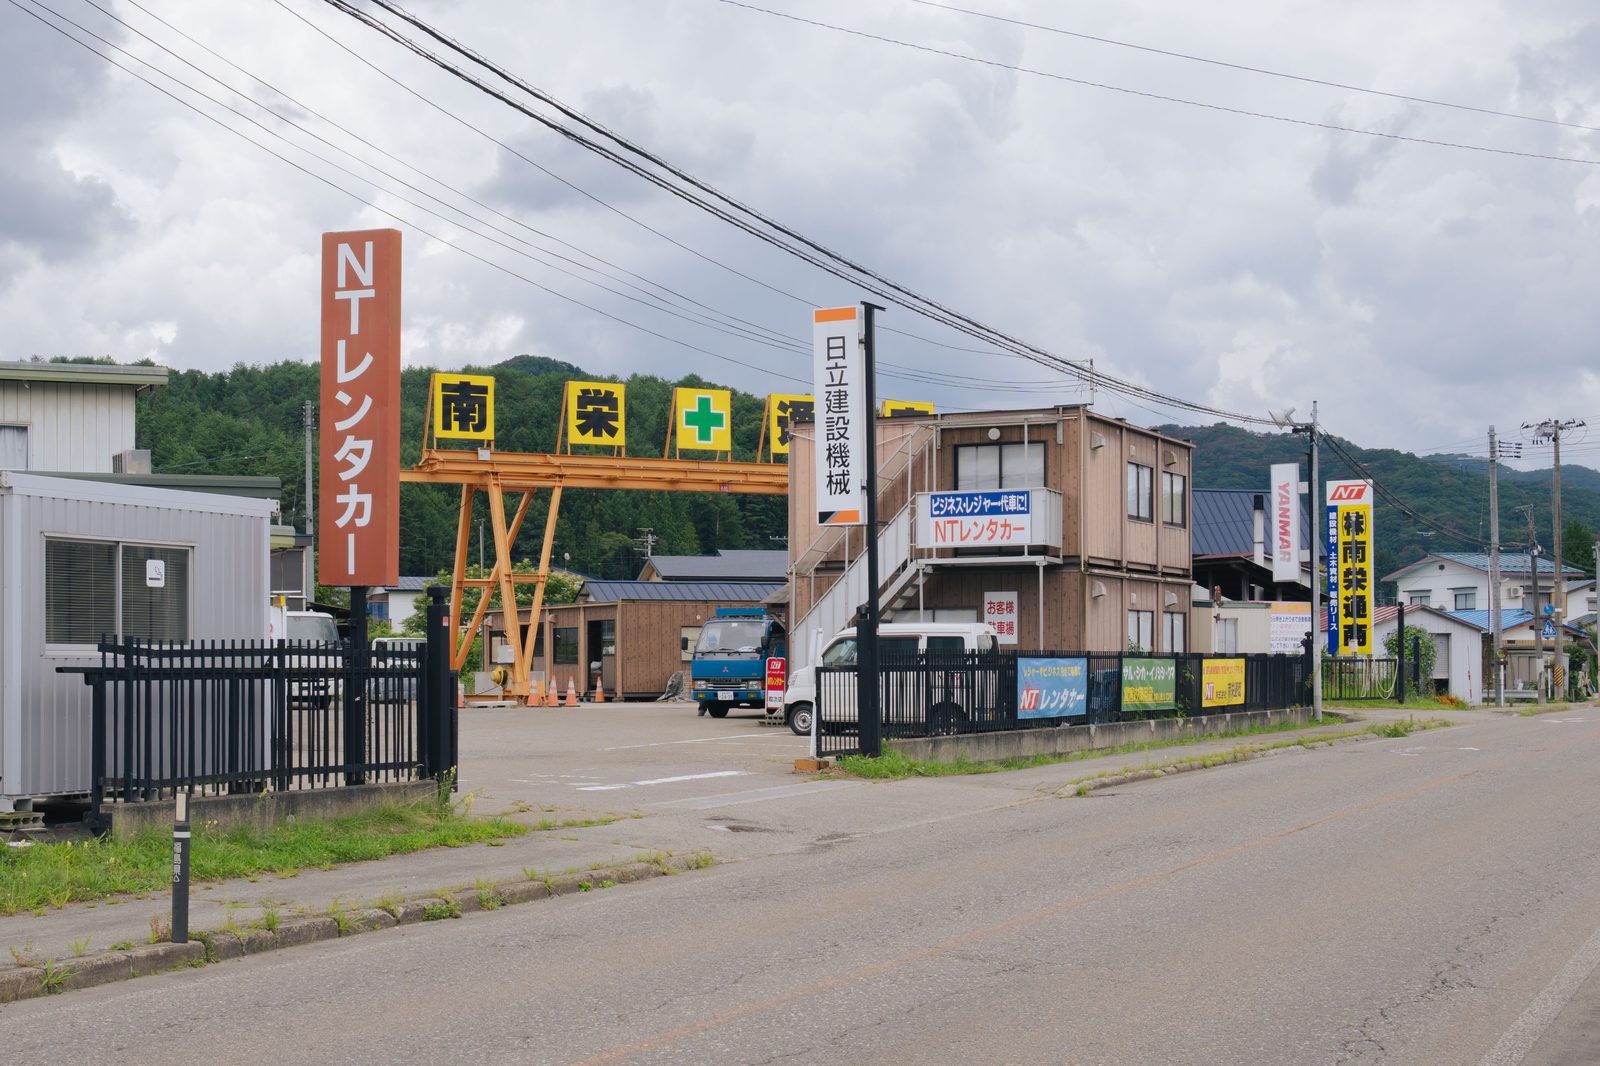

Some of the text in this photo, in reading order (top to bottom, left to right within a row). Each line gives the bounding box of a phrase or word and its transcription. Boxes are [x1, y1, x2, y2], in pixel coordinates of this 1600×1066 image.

[334, 240, 374, 576] NTレンタカー
[824, 335, 850, 496] 日立建設機械
[934, 518, 1025, 543] NTレンタカー
[1278, 481, 1292, 563] YANMAR
[987, 600, 1015, 615] お客様
